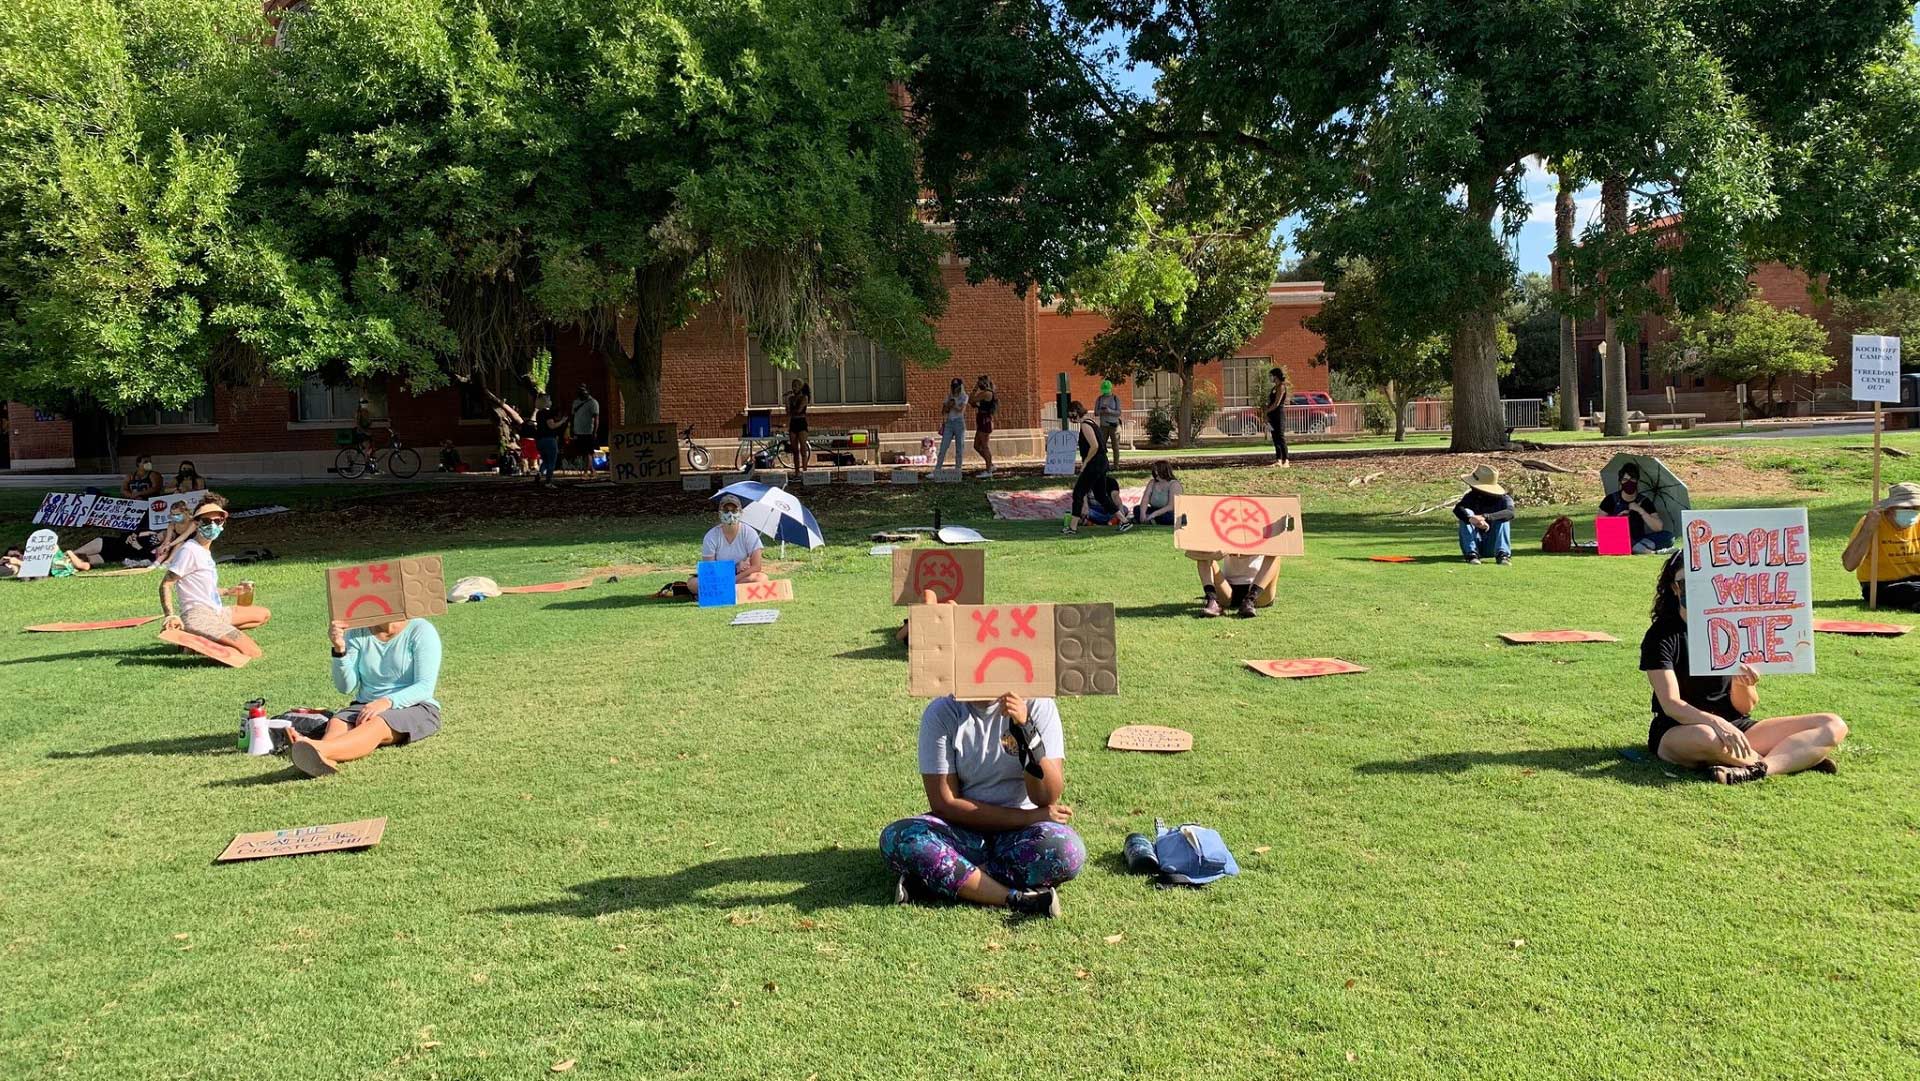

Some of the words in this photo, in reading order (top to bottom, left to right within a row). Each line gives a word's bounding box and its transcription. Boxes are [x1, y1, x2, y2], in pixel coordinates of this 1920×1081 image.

[613, 431, 668, 450] PEOPLE
[615, 456, 676, 480] PROFIT
[72, 505, 88, 515] US
[151, 501, 167, 511] STOP
[112, 521, 140, 530] DOWN
[1687, 519, 1807, 571] PEOPLE
[1711, 571, 1797, 605] WILL
[1707, 614, 1793, 671] DIE
